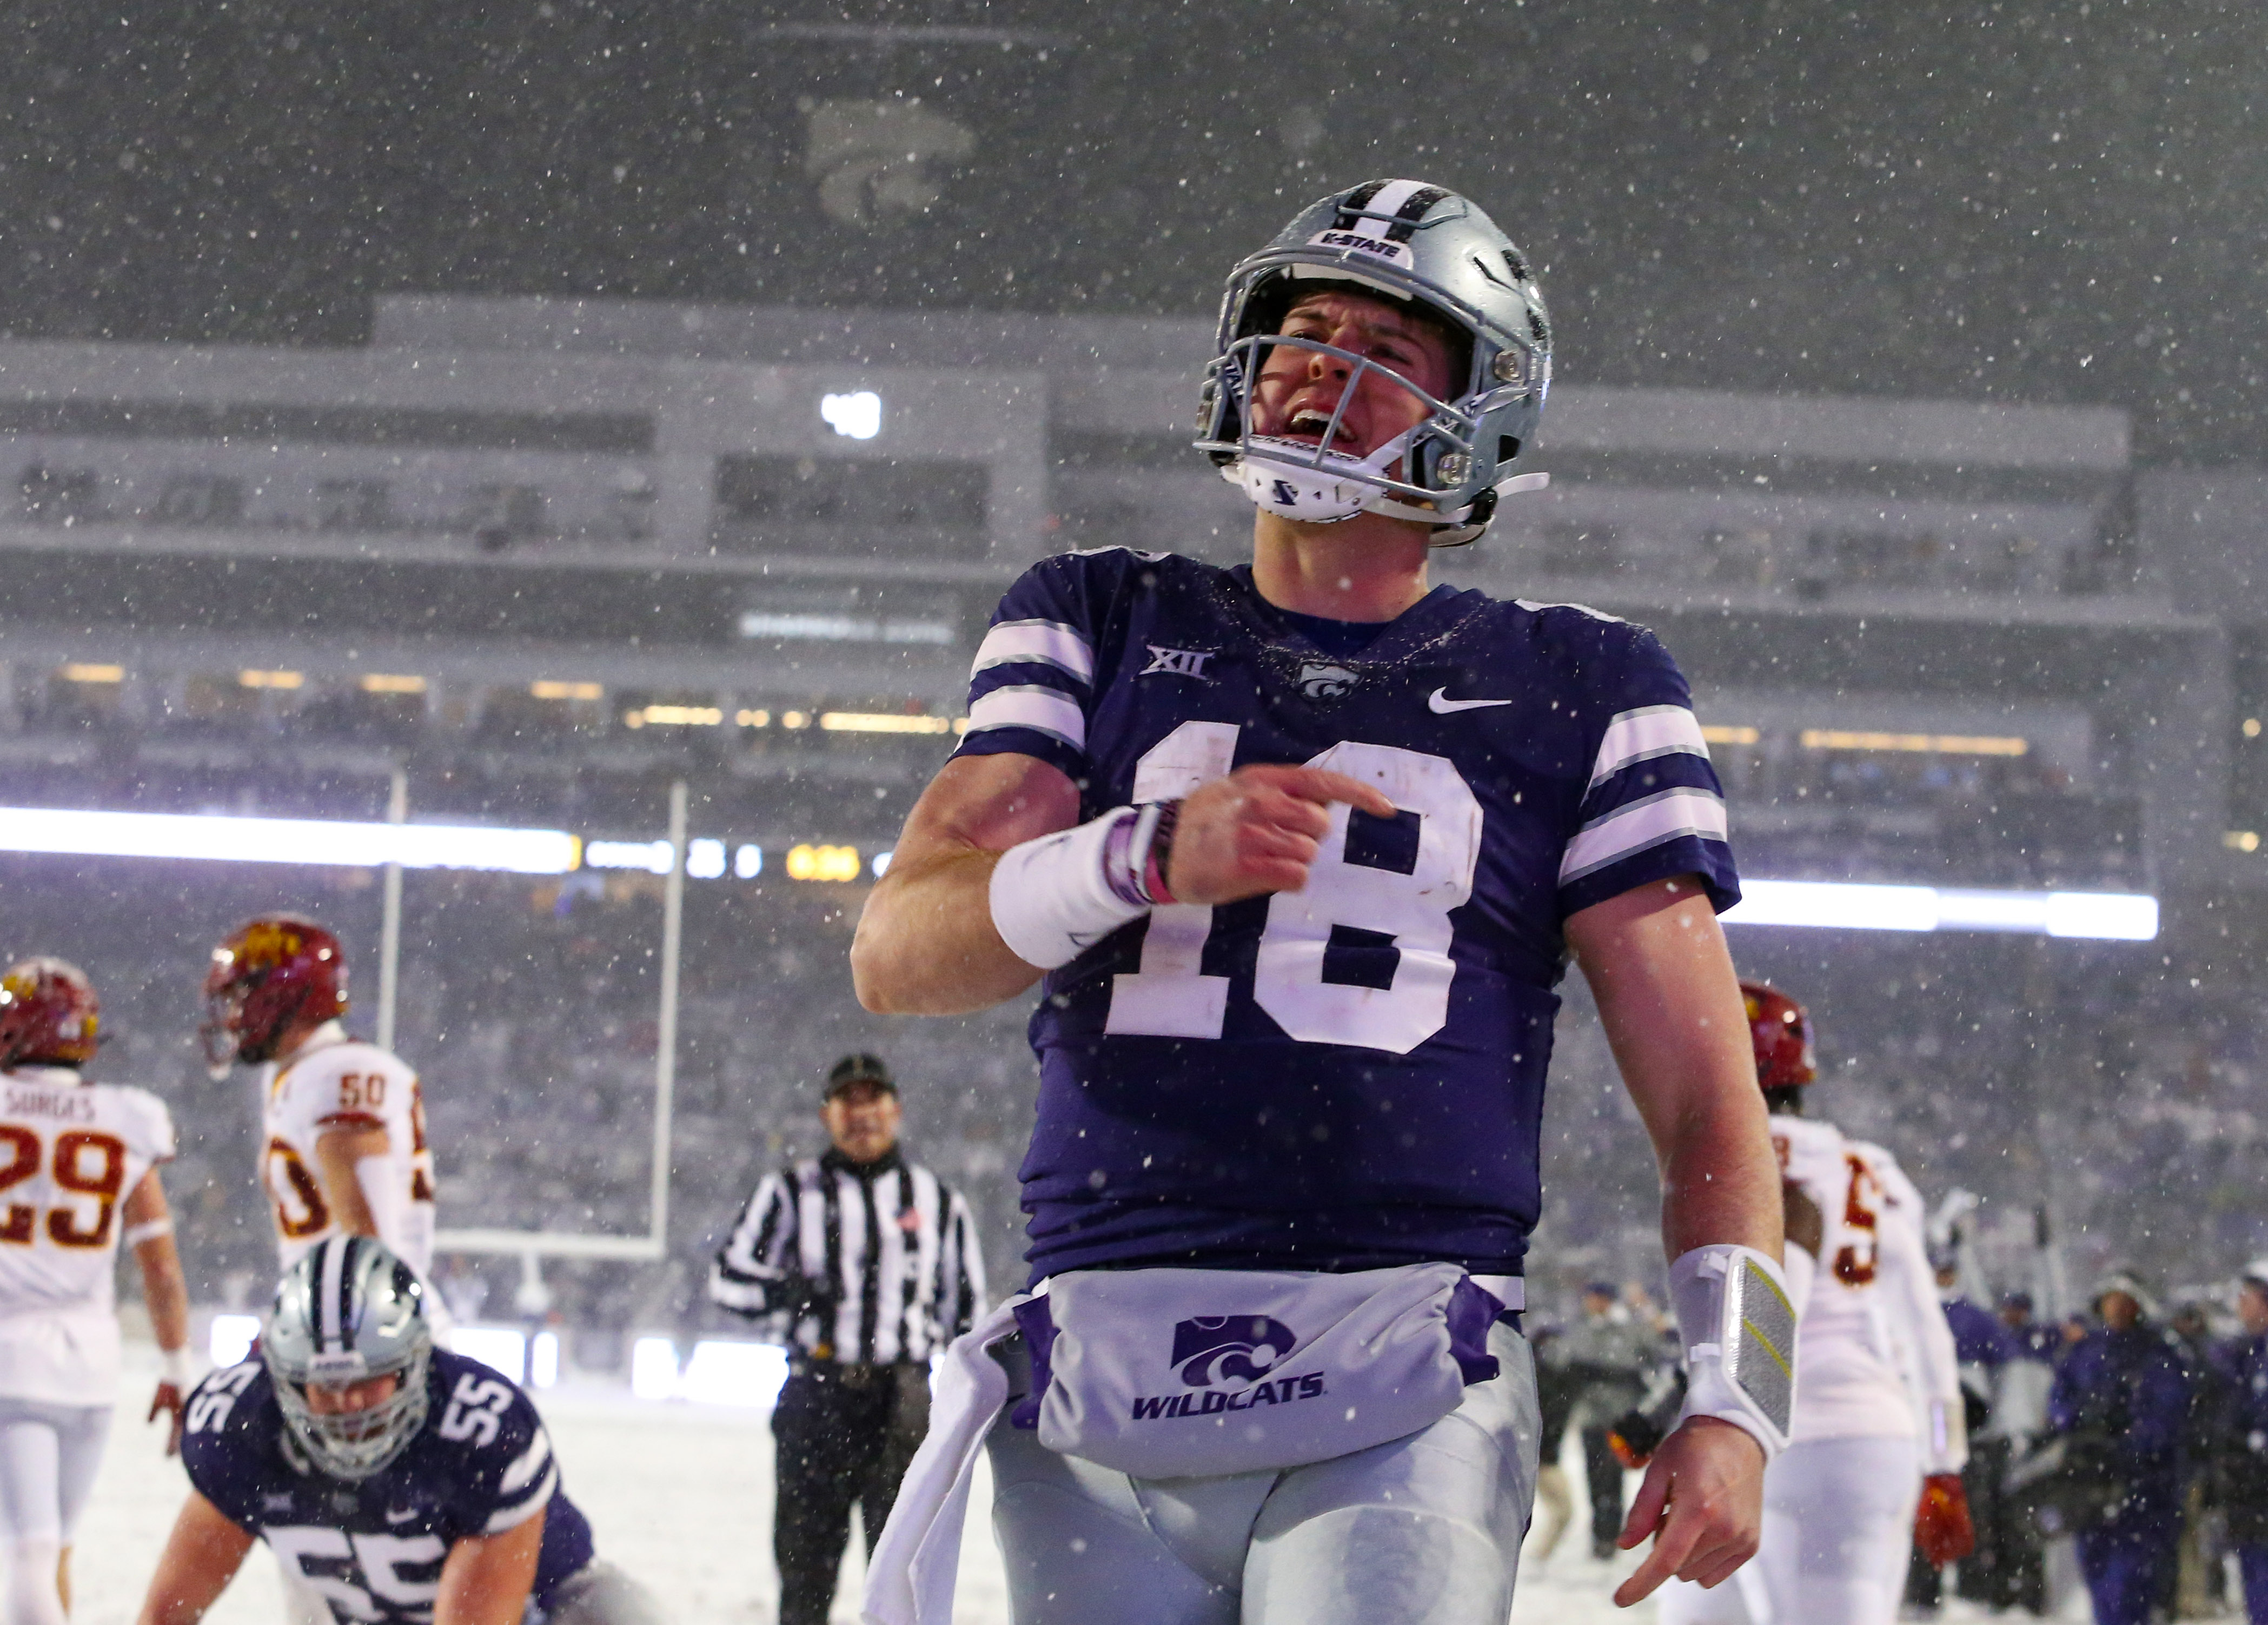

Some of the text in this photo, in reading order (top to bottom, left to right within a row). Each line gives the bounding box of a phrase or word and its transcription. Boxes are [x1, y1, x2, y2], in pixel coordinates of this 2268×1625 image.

[1321, 233, 1401, 257] K-STATE
[1138, 644, 1216, 680] XII
[1104, 720, 1484, 1056] 18
[339, 1072, 386, 1109] 50
[439, 1372, 514, 1449] 55
[1132, 1371, 1325, 1420] WILDCATS
